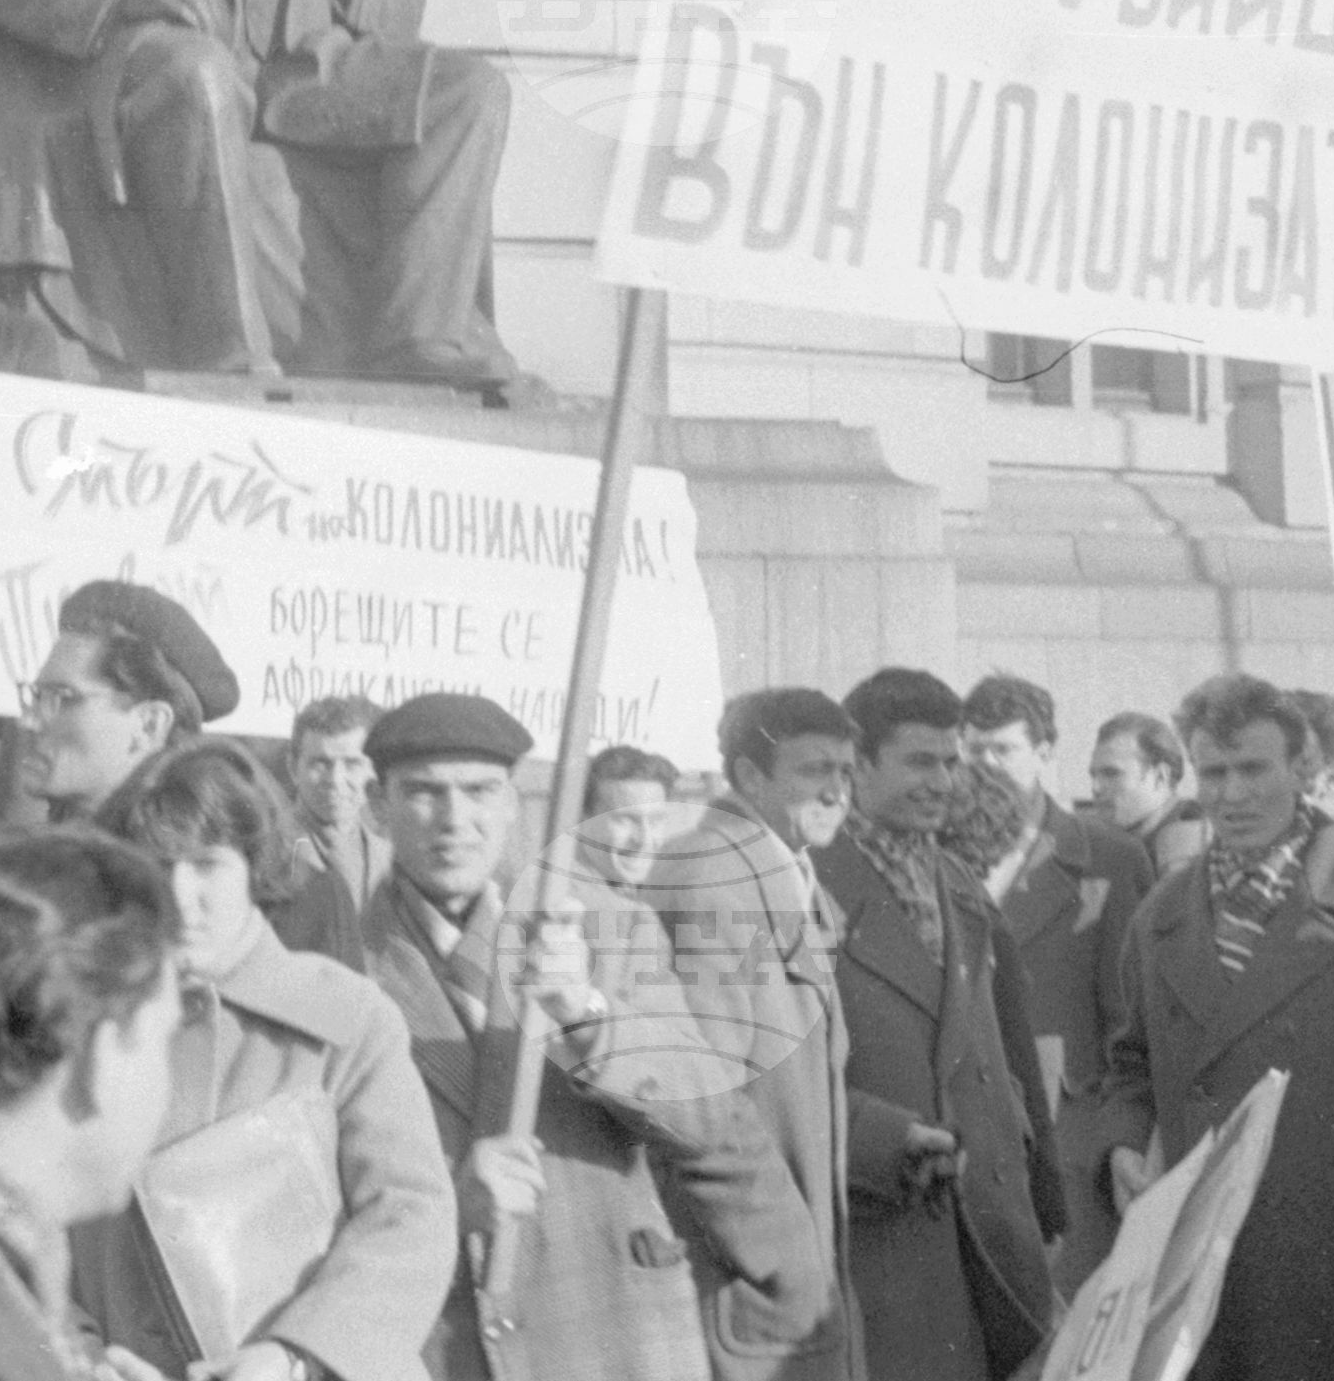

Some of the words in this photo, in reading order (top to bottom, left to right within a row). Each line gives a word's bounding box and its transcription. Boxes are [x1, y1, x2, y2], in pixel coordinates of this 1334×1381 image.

[632, 2, 887, 268] ВЪН
[344, 475, 677, 584] КОЛОНИАЛИЗА!
[268, 584, 478, 661] БОРЕЩИТЕ
[497, 606, 545, 662] СЕ
[509, 674, 662, 744] НАРДИ!
